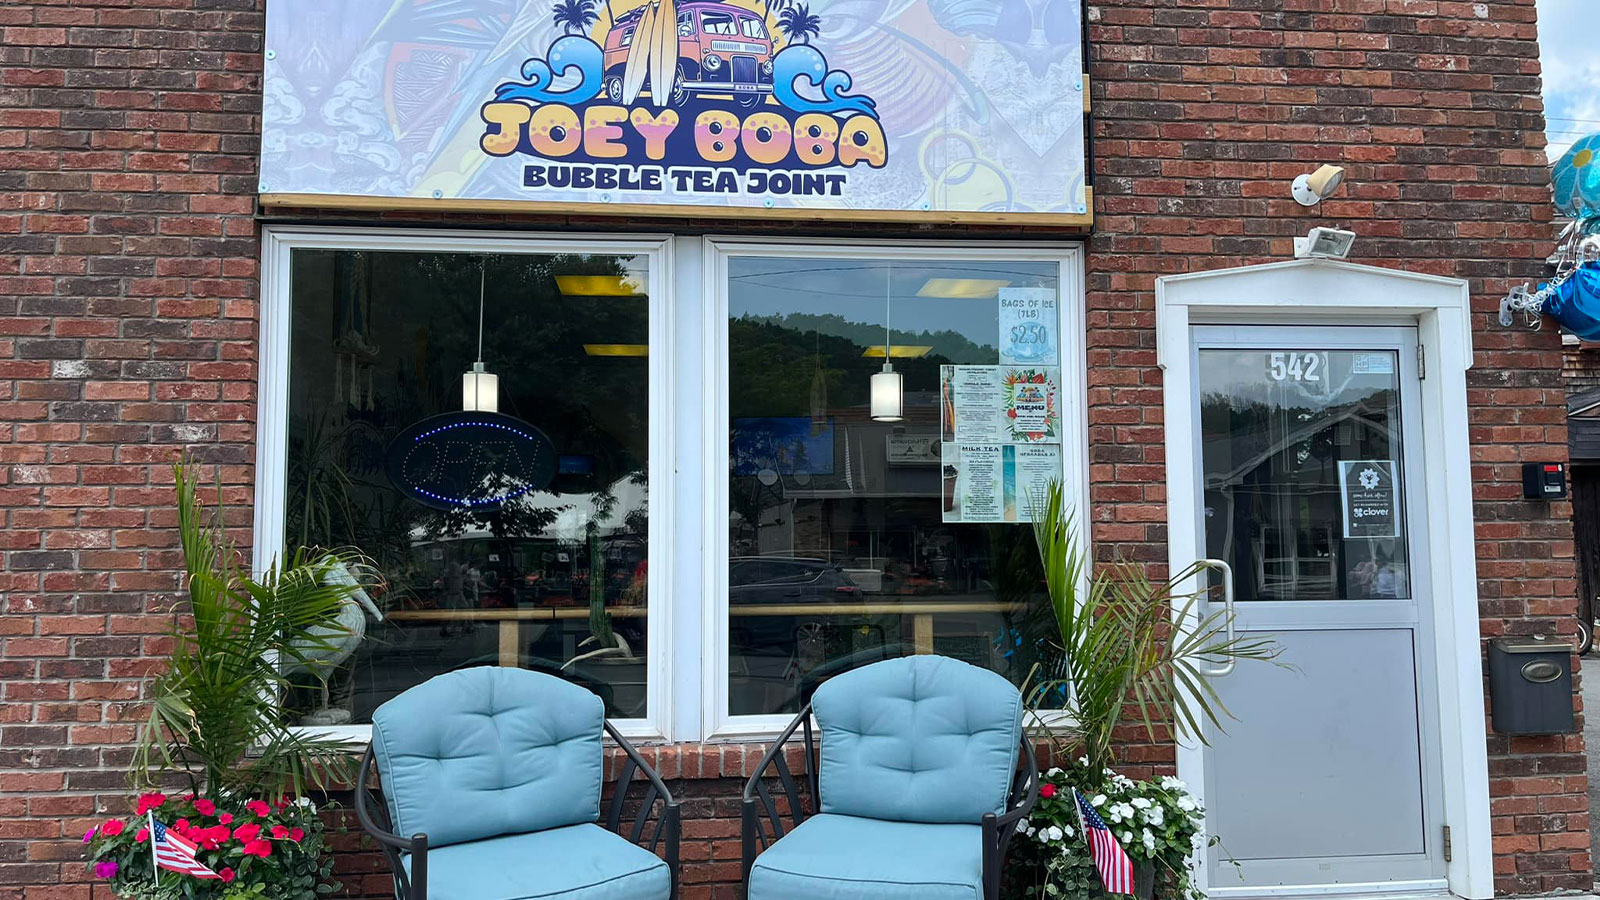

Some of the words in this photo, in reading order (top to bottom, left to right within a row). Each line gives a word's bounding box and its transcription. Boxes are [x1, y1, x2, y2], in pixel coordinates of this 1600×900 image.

[481, 102, 680, 161] JOEY
[693, 109, 888, 169] BOBA
[523, 164, 663, 191] BUBBLE
[671, 169, 740, 194] TEA
[746, 172, 847, 196] JOINT
[1001, 299, 1025, 308] BAGS
[1028, 299, 1039, 308] OF
[1042, 299, 1054, 308] ICE
[1017, 309, 1040, 320] (7LB)
[1010, 325, 1047, 345] $2.50
[1270, 351, 1320, 381] 542
[403, 441, 541, 485] OPEN
[1363, 507, 1389, 516] clover
